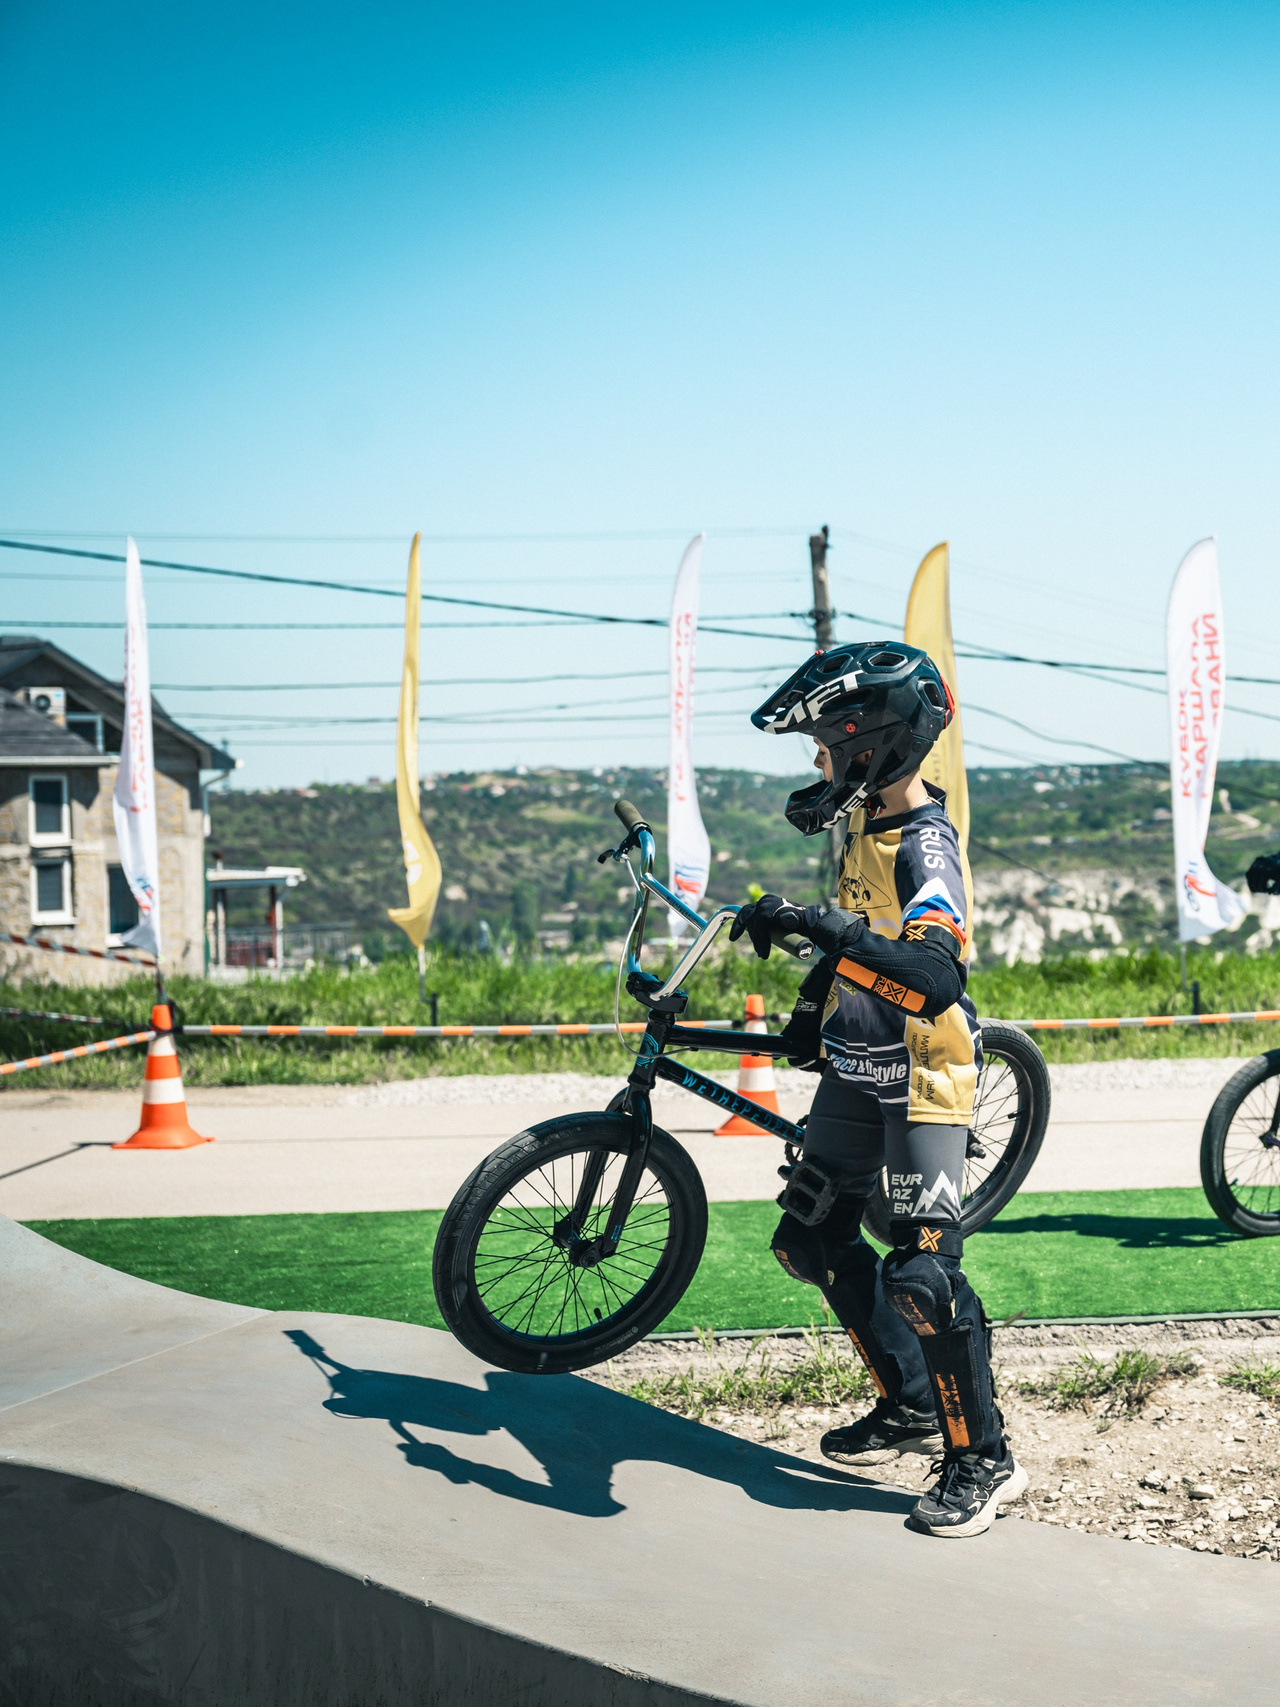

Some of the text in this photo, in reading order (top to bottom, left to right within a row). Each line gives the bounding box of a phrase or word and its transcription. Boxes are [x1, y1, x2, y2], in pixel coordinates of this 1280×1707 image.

[764, 669, 865, 734] MET
[822, 782, 869, 829] MET
[918, 827, 946, 870] RUS
[829, 1053, 857, 1072] race
[857, 1059, 865, 1073] &
[891, 1173, 923, 1187] EVR
[892, 1188, 913, 1200] AZ
[893, 1202, 914, 1214] EN
